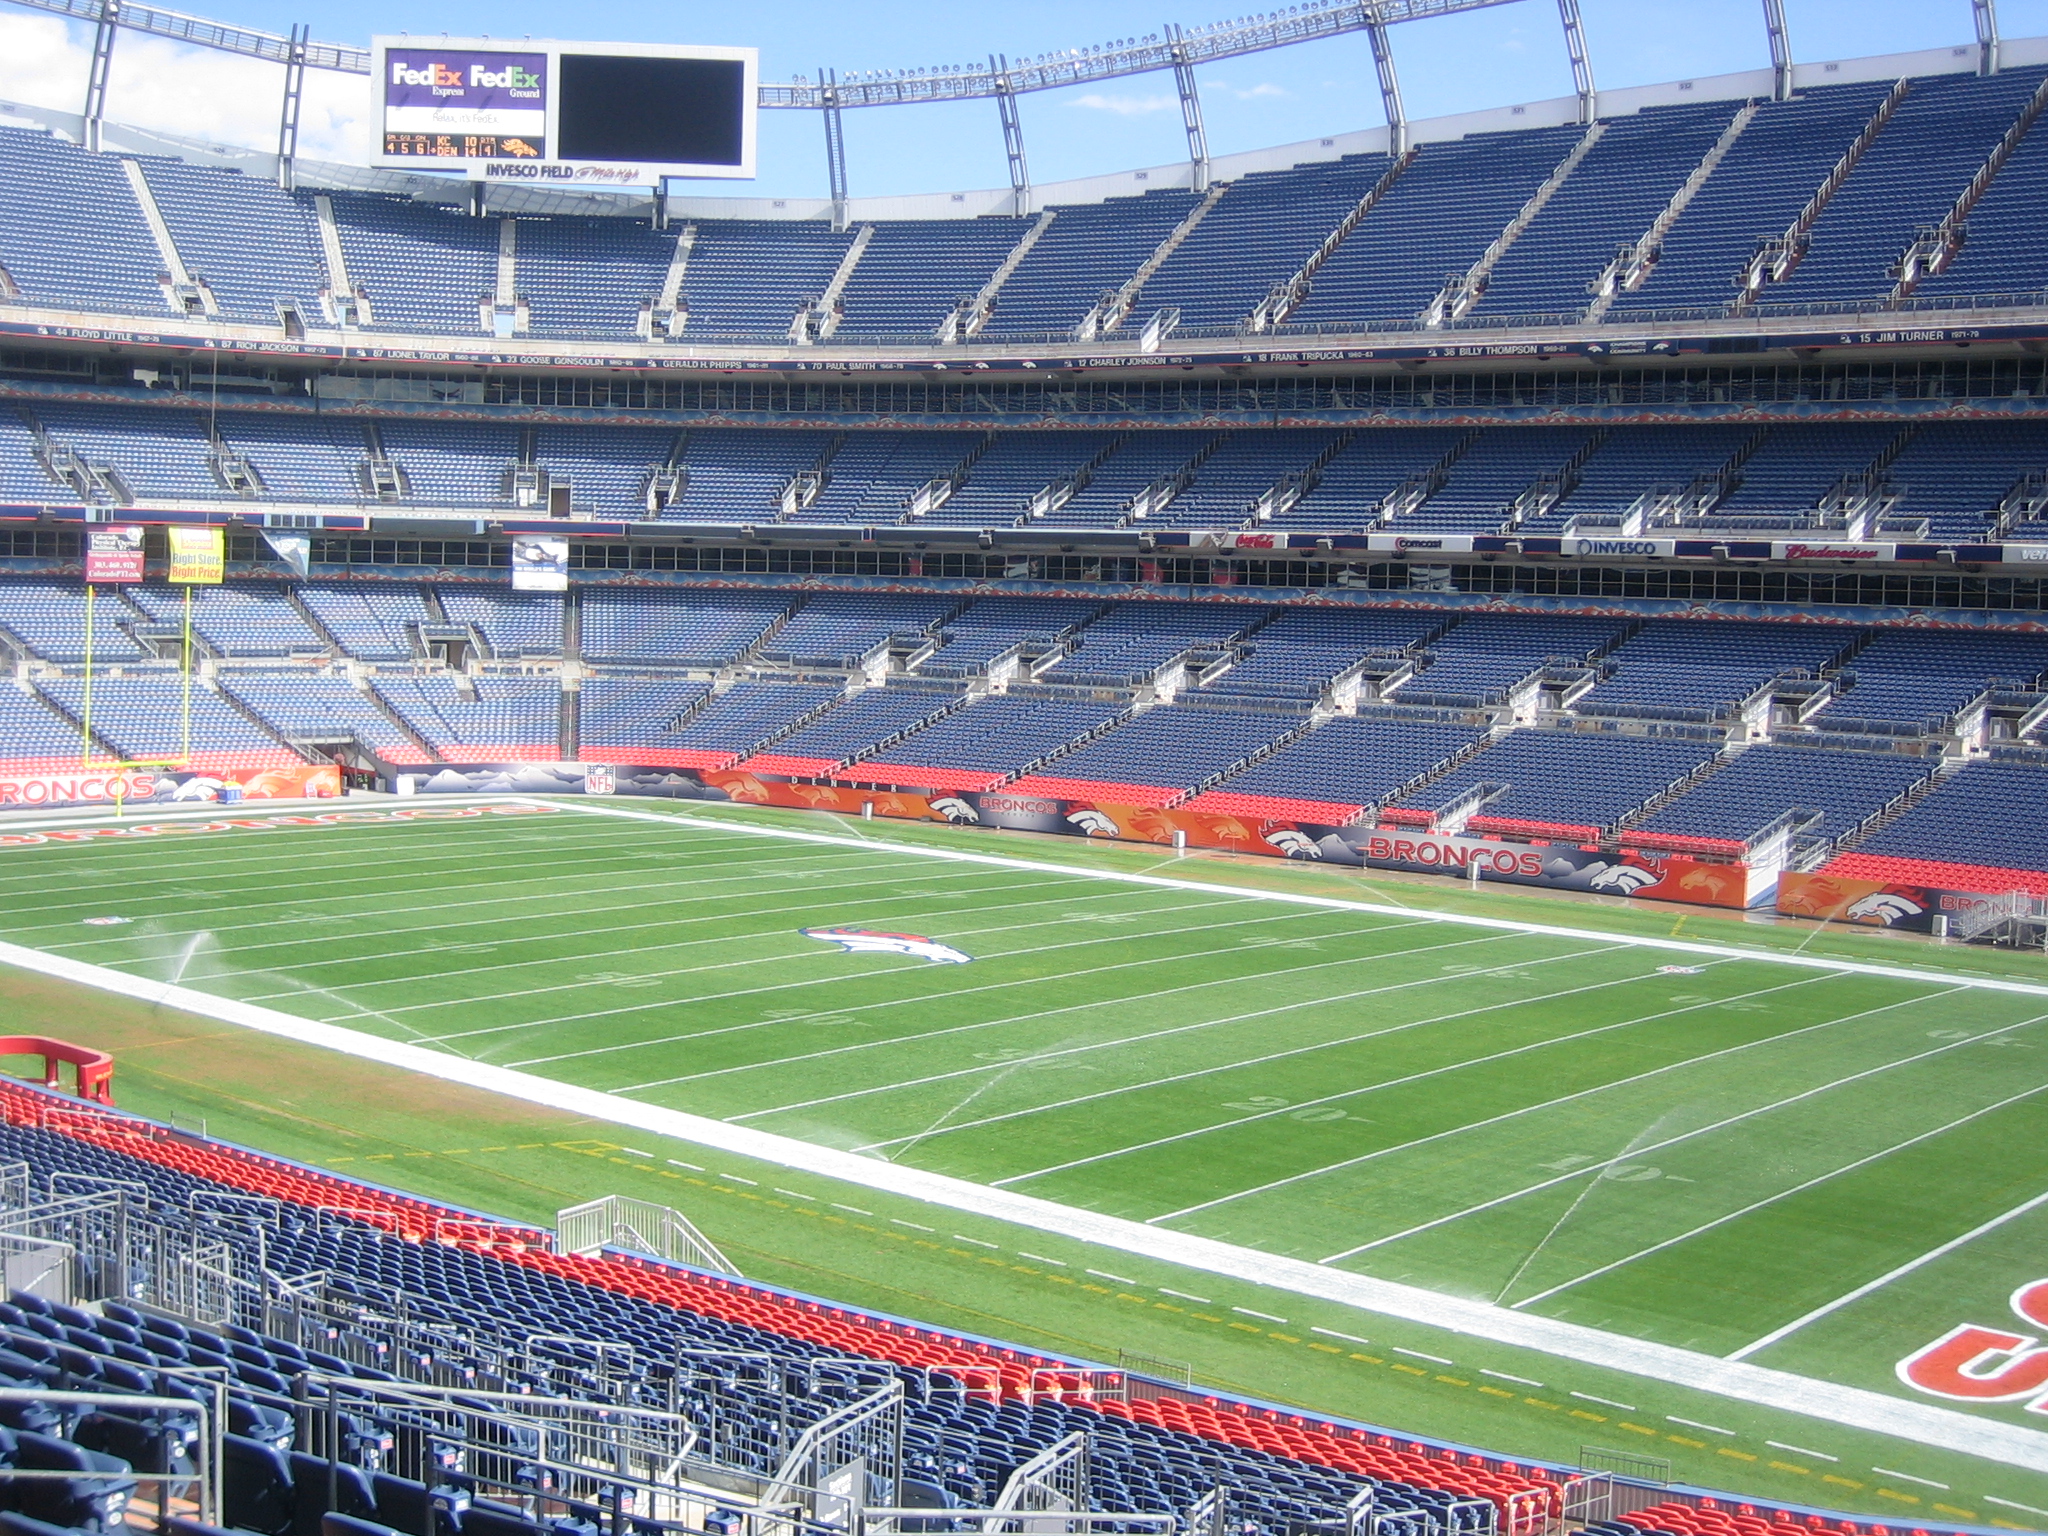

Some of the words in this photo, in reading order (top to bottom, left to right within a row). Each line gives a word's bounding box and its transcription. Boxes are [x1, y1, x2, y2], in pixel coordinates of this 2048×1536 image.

[393, 63, 463, 86] FedEx
[470, 65, 541, 88] FedEx
[432, 86, 465, 98] Express
[509, 88, 541, 98] Ground
[437, 136, 451, 146] KC
[437, 147, 459, 157] DEN
[486, 163, 539, 178] INVESCO
[540, 165, 574, 179] FIELD
[71, 328, 101, 340] FLOYD
[103, 330, 133, 342] LITTLE
[1859, 334, 1871, 343] 15
[1876, 333, 1896, 342] JIM
[1900, 331, 1944, 341] TURNER
[236, 341, 257, 351] RICH
[259, 342, 299, 353] JACKSON
[1459, 347, 1482, 356] BILLY
[1485, 345, 1538, 356] THOMPSON
[387, 350, 417, 360] LIONEL
[418, 351, 450, 361] TAYLOR
[520, 356, 551, 365] GOOSE
[554, 357, 604, 367] GONSOULIN
[1078, 359, 1086, 367] 12
[1089, 358, 1127, 367] CHARLEY
[1127, 356, 1167, 366] JOHNSON
[1270, 353, 1299, 362] FRANK
[1302, 351, 1345, 361] TRIPUCKA
[662, 359, 699, 369] GERALD
[709, 360, 743, 370] PHIPPS
[811, 362, 823, 371] 70
[826, 362, 847, 371] PAUL
[848, 362, 876, 371] SMITH
[1235, 533, 1275, 549] Coca-Cola
[1592, 541, 1656, 556] INVESCO
[1785, 543, 1879, 560] Budweiser
[173, 553, 196, 566] Right
[172, 566, 196, 579] Right
[587, 775, 613, 792] NFL
[979, 796, 1058, 815] BRONCOS
[1368, 836, 1543, 876] BRONCOS
